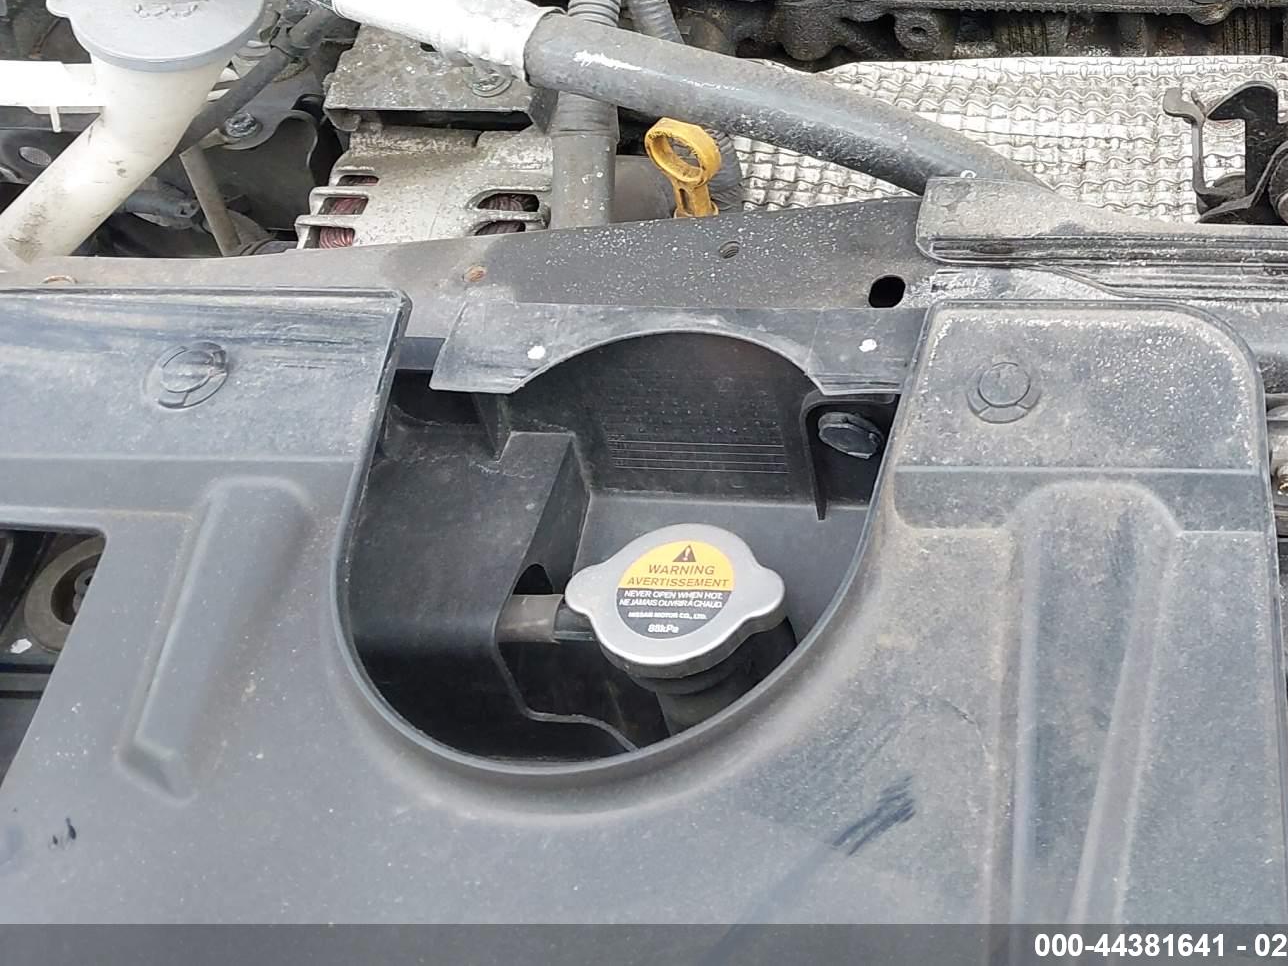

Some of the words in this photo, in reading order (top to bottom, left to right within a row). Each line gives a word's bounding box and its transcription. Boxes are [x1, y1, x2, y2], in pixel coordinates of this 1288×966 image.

[648, 564, 715, 575] WARNING
[627, 577, 730, 587] AVERTISSEMENT
[624, 590, 652, 598] NEVER
[652, 591, 677, 599] OPEN
[678, 591, 704, 600] WHEN
